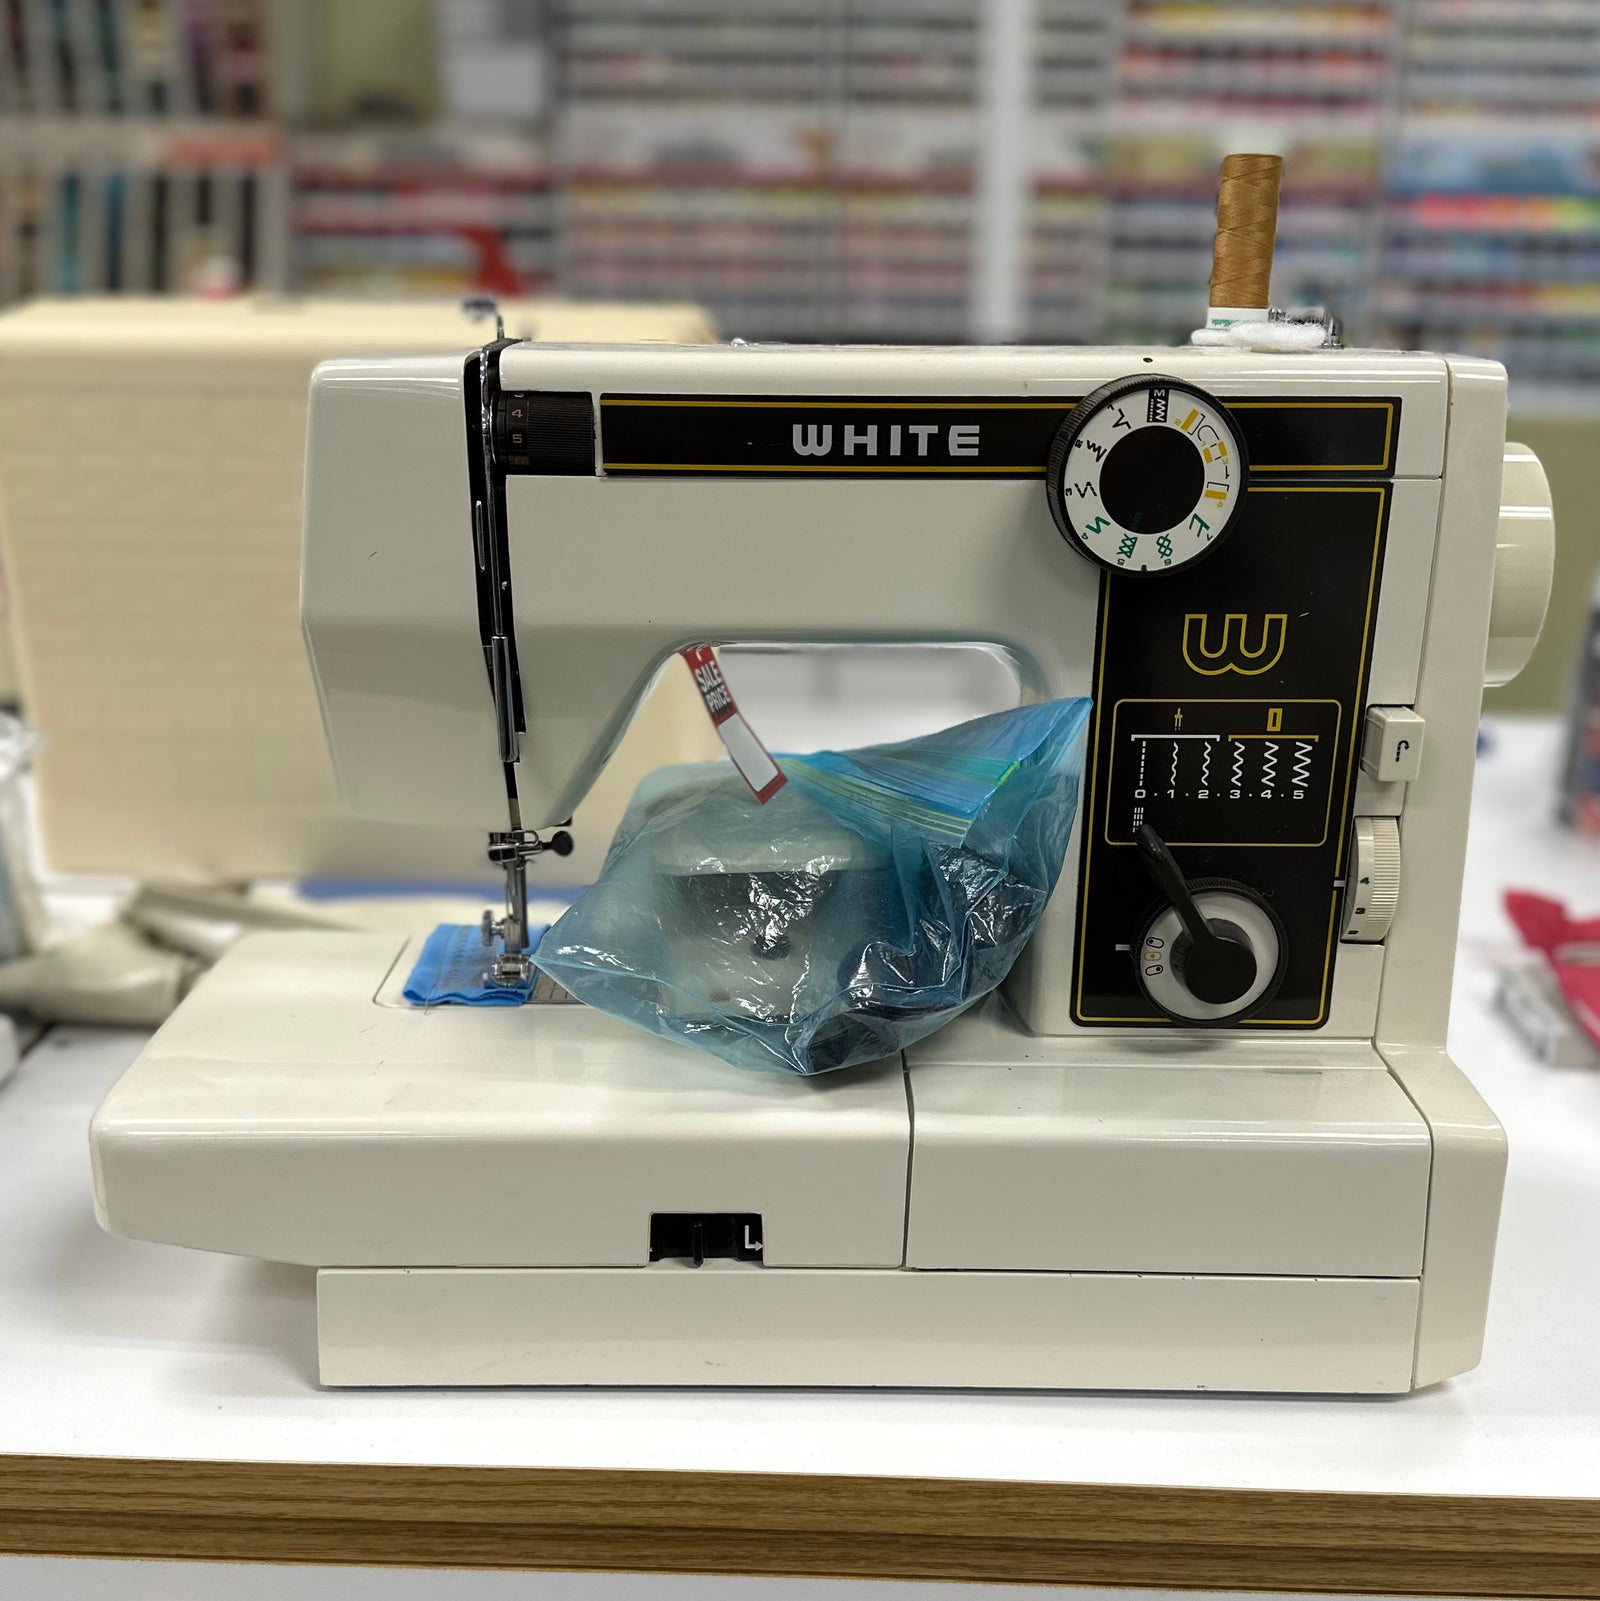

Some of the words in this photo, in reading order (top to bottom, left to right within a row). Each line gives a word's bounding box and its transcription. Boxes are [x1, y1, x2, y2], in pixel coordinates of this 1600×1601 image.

[1154, 389, 1165, 397] M
[512, 409, 522, 418] 4
[792, 424, 980, 456] WHITE
[1065, 487, 1072, 496] 3
[1081, 532, 1089, 540] 4
[694, 660, 722, 692] SALE
[706, 684, 731, 713] PRICE
[1134, 789, 1146, 799] 0
[1167, 789, 1175, 799] 1
[1198, 790, 1209, 799] 2
[1229, 790, 1241, 799] 3
[1260, 790, 1272, 799] 4
[1292, 790, 1304, 800] 5
[1360, 877, 1370, 885] 4
